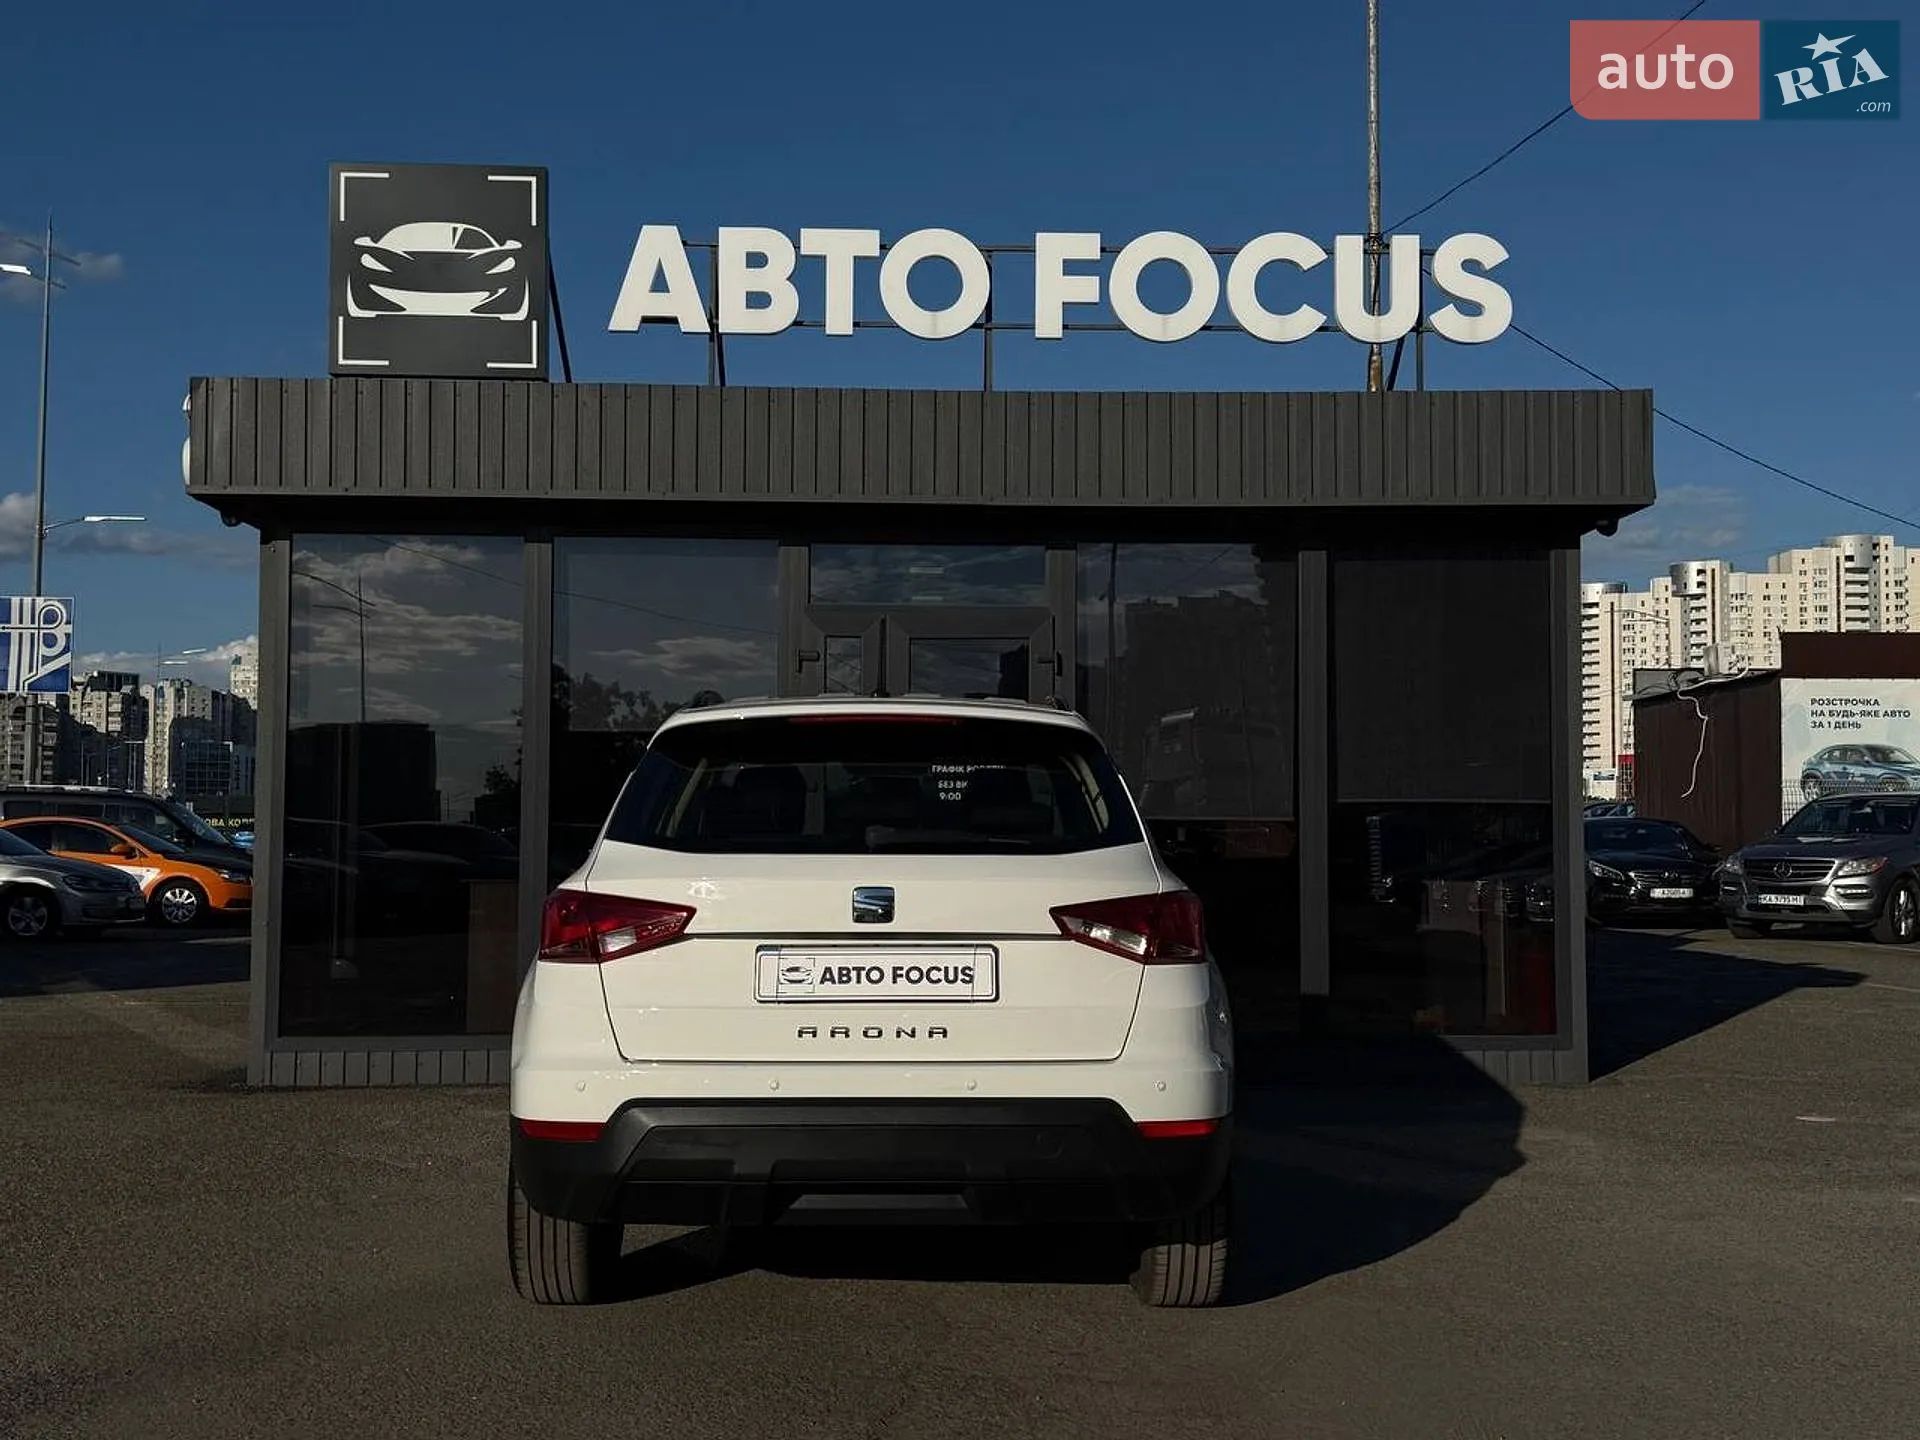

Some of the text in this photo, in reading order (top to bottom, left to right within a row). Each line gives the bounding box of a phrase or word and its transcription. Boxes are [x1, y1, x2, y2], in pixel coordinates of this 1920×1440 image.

[608, 224, 1514, 344] АВТО FOCUS
[1810, 698, 1880, 706] РОЗСТРОЧКА
[1810, 709, 1911, 719] НА БУДЬ-ЯКЕ АВТО
[1810, 720, 1825, 729] ЗА
[1834, 720, 1862, 730] ДЕНЬ
[820, 966, 975, 985] АВТО FOCUS
[797, 1026, 949, 1039] ARONA
